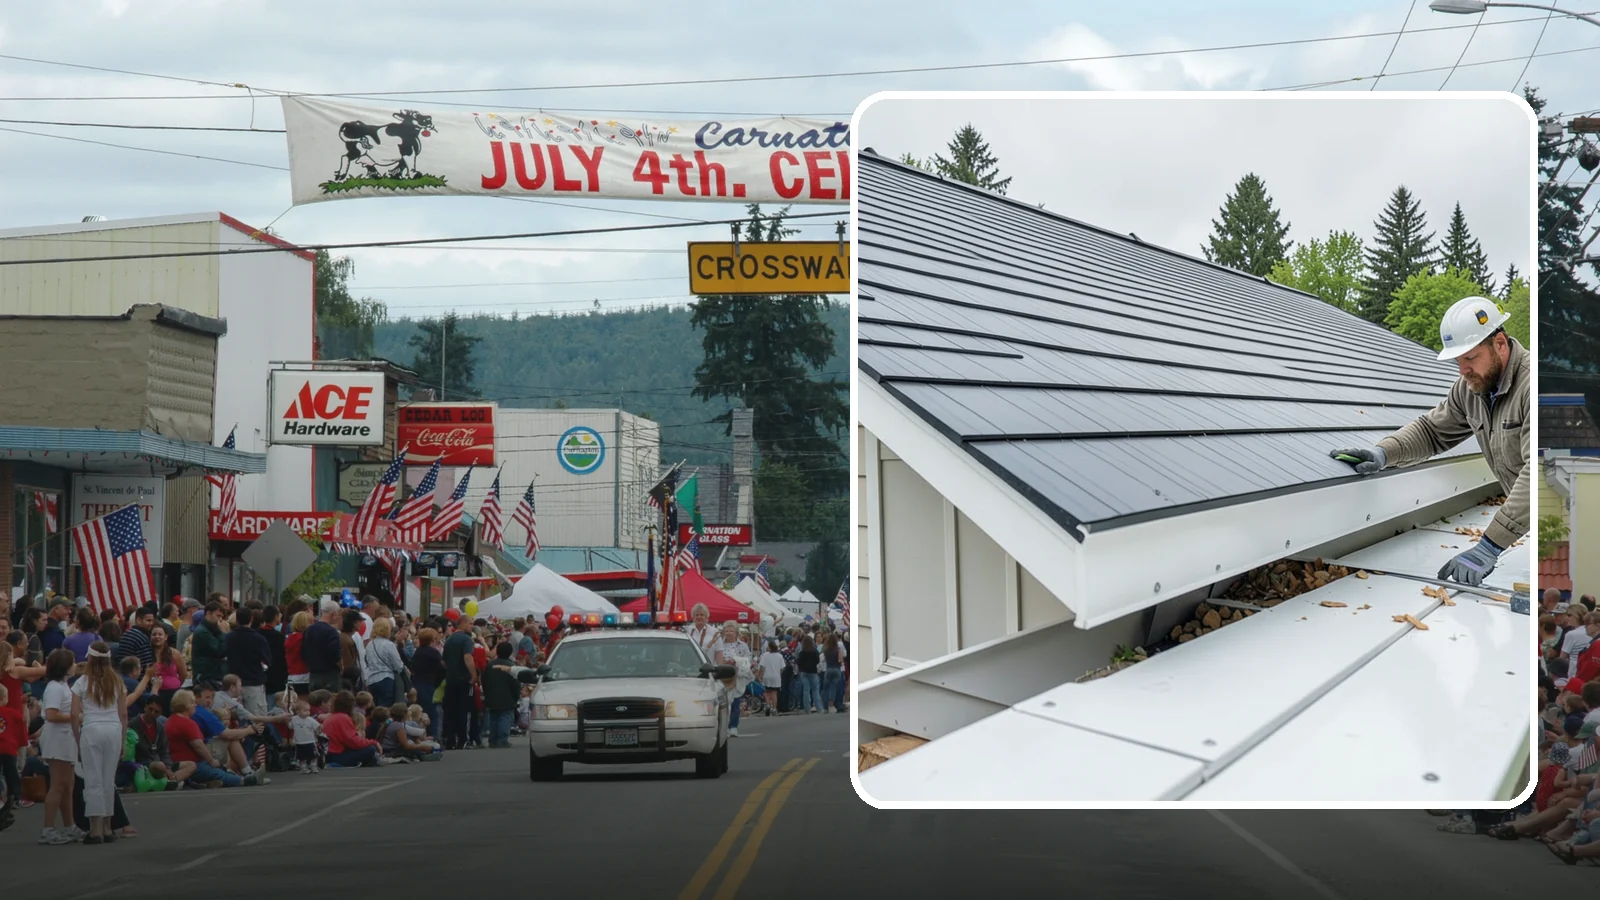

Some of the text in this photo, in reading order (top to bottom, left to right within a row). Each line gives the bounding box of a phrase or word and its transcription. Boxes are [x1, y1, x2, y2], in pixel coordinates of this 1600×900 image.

[695, 121, 850, 150] Carnat
[481, 141, 605, 193] JULY
[632, 150, 746, 198] 4th.
[697, 254, 850, 280] CROSSWA
[283, 380, 373, 420] ACE
[406, 410, 452, 421] CEDAR
[283, 421, 371, 436] Hardware
[96, 485, 124, 494] Vincent
[126, 486, 135, 495] de
[138, 486, 155, 495] Paul
[688, 526, 741, 535] CRNATION
